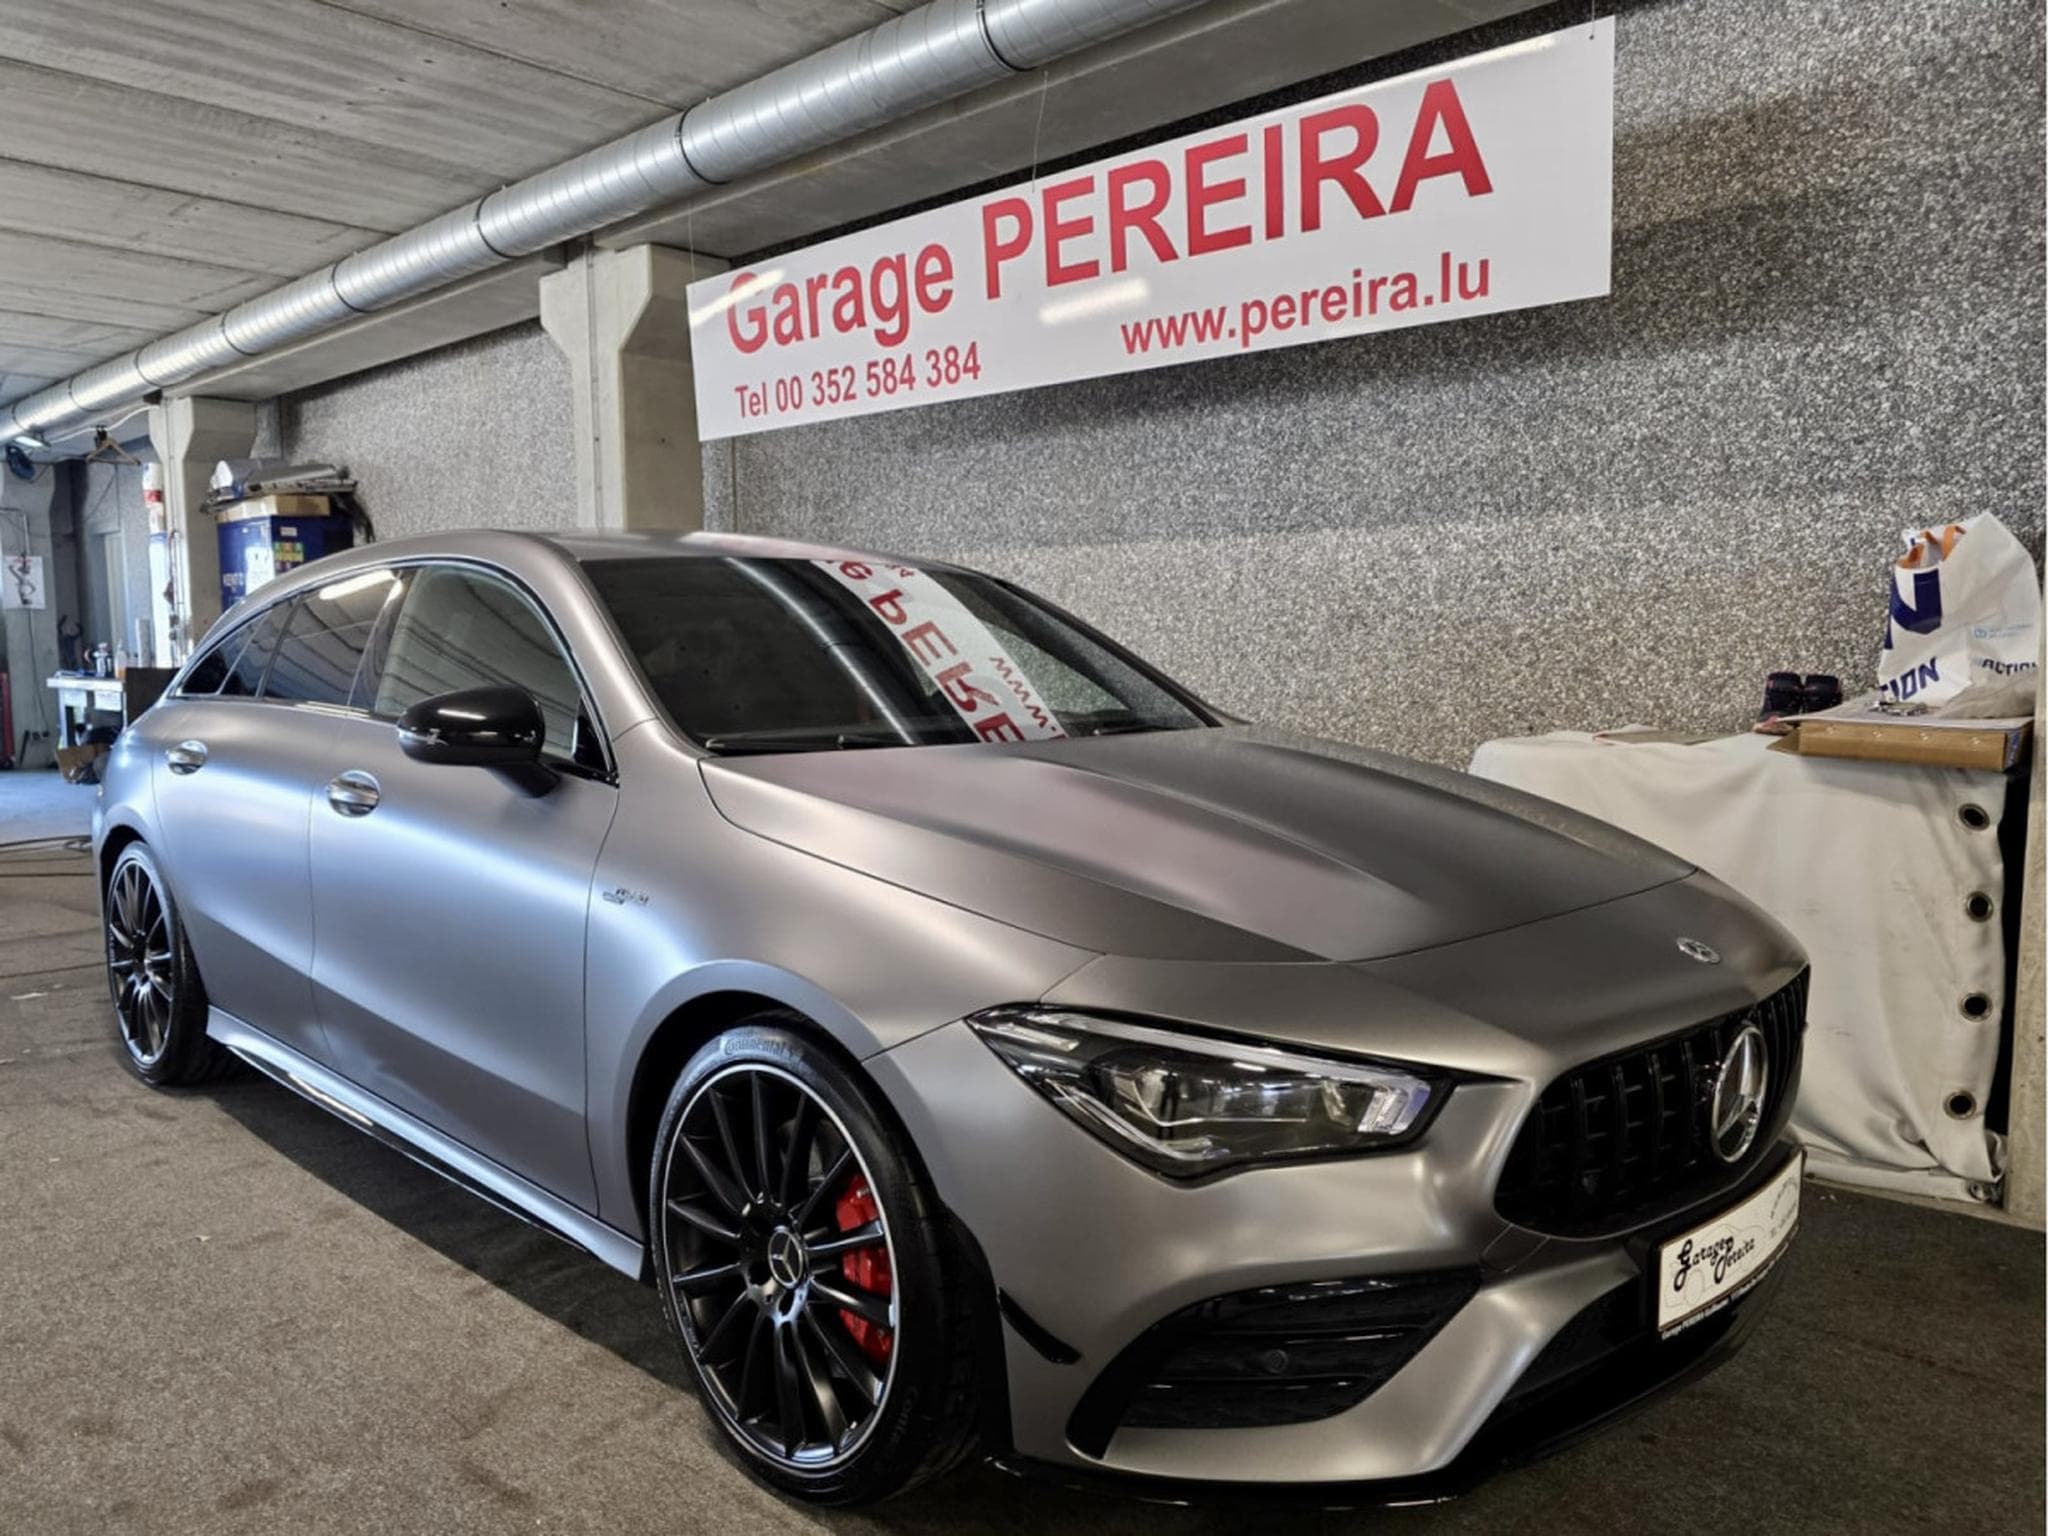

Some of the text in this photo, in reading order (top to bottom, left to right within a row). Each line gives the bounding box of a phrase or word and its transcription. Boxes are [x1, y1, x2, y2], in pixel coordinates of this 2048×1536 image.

[727, 78, 1493, 354] Garage PEREIRA
[1121, 251, 1490, 354] www.pereira.lu
[735, 341, 980, 418] Tel 00 352 584 384
